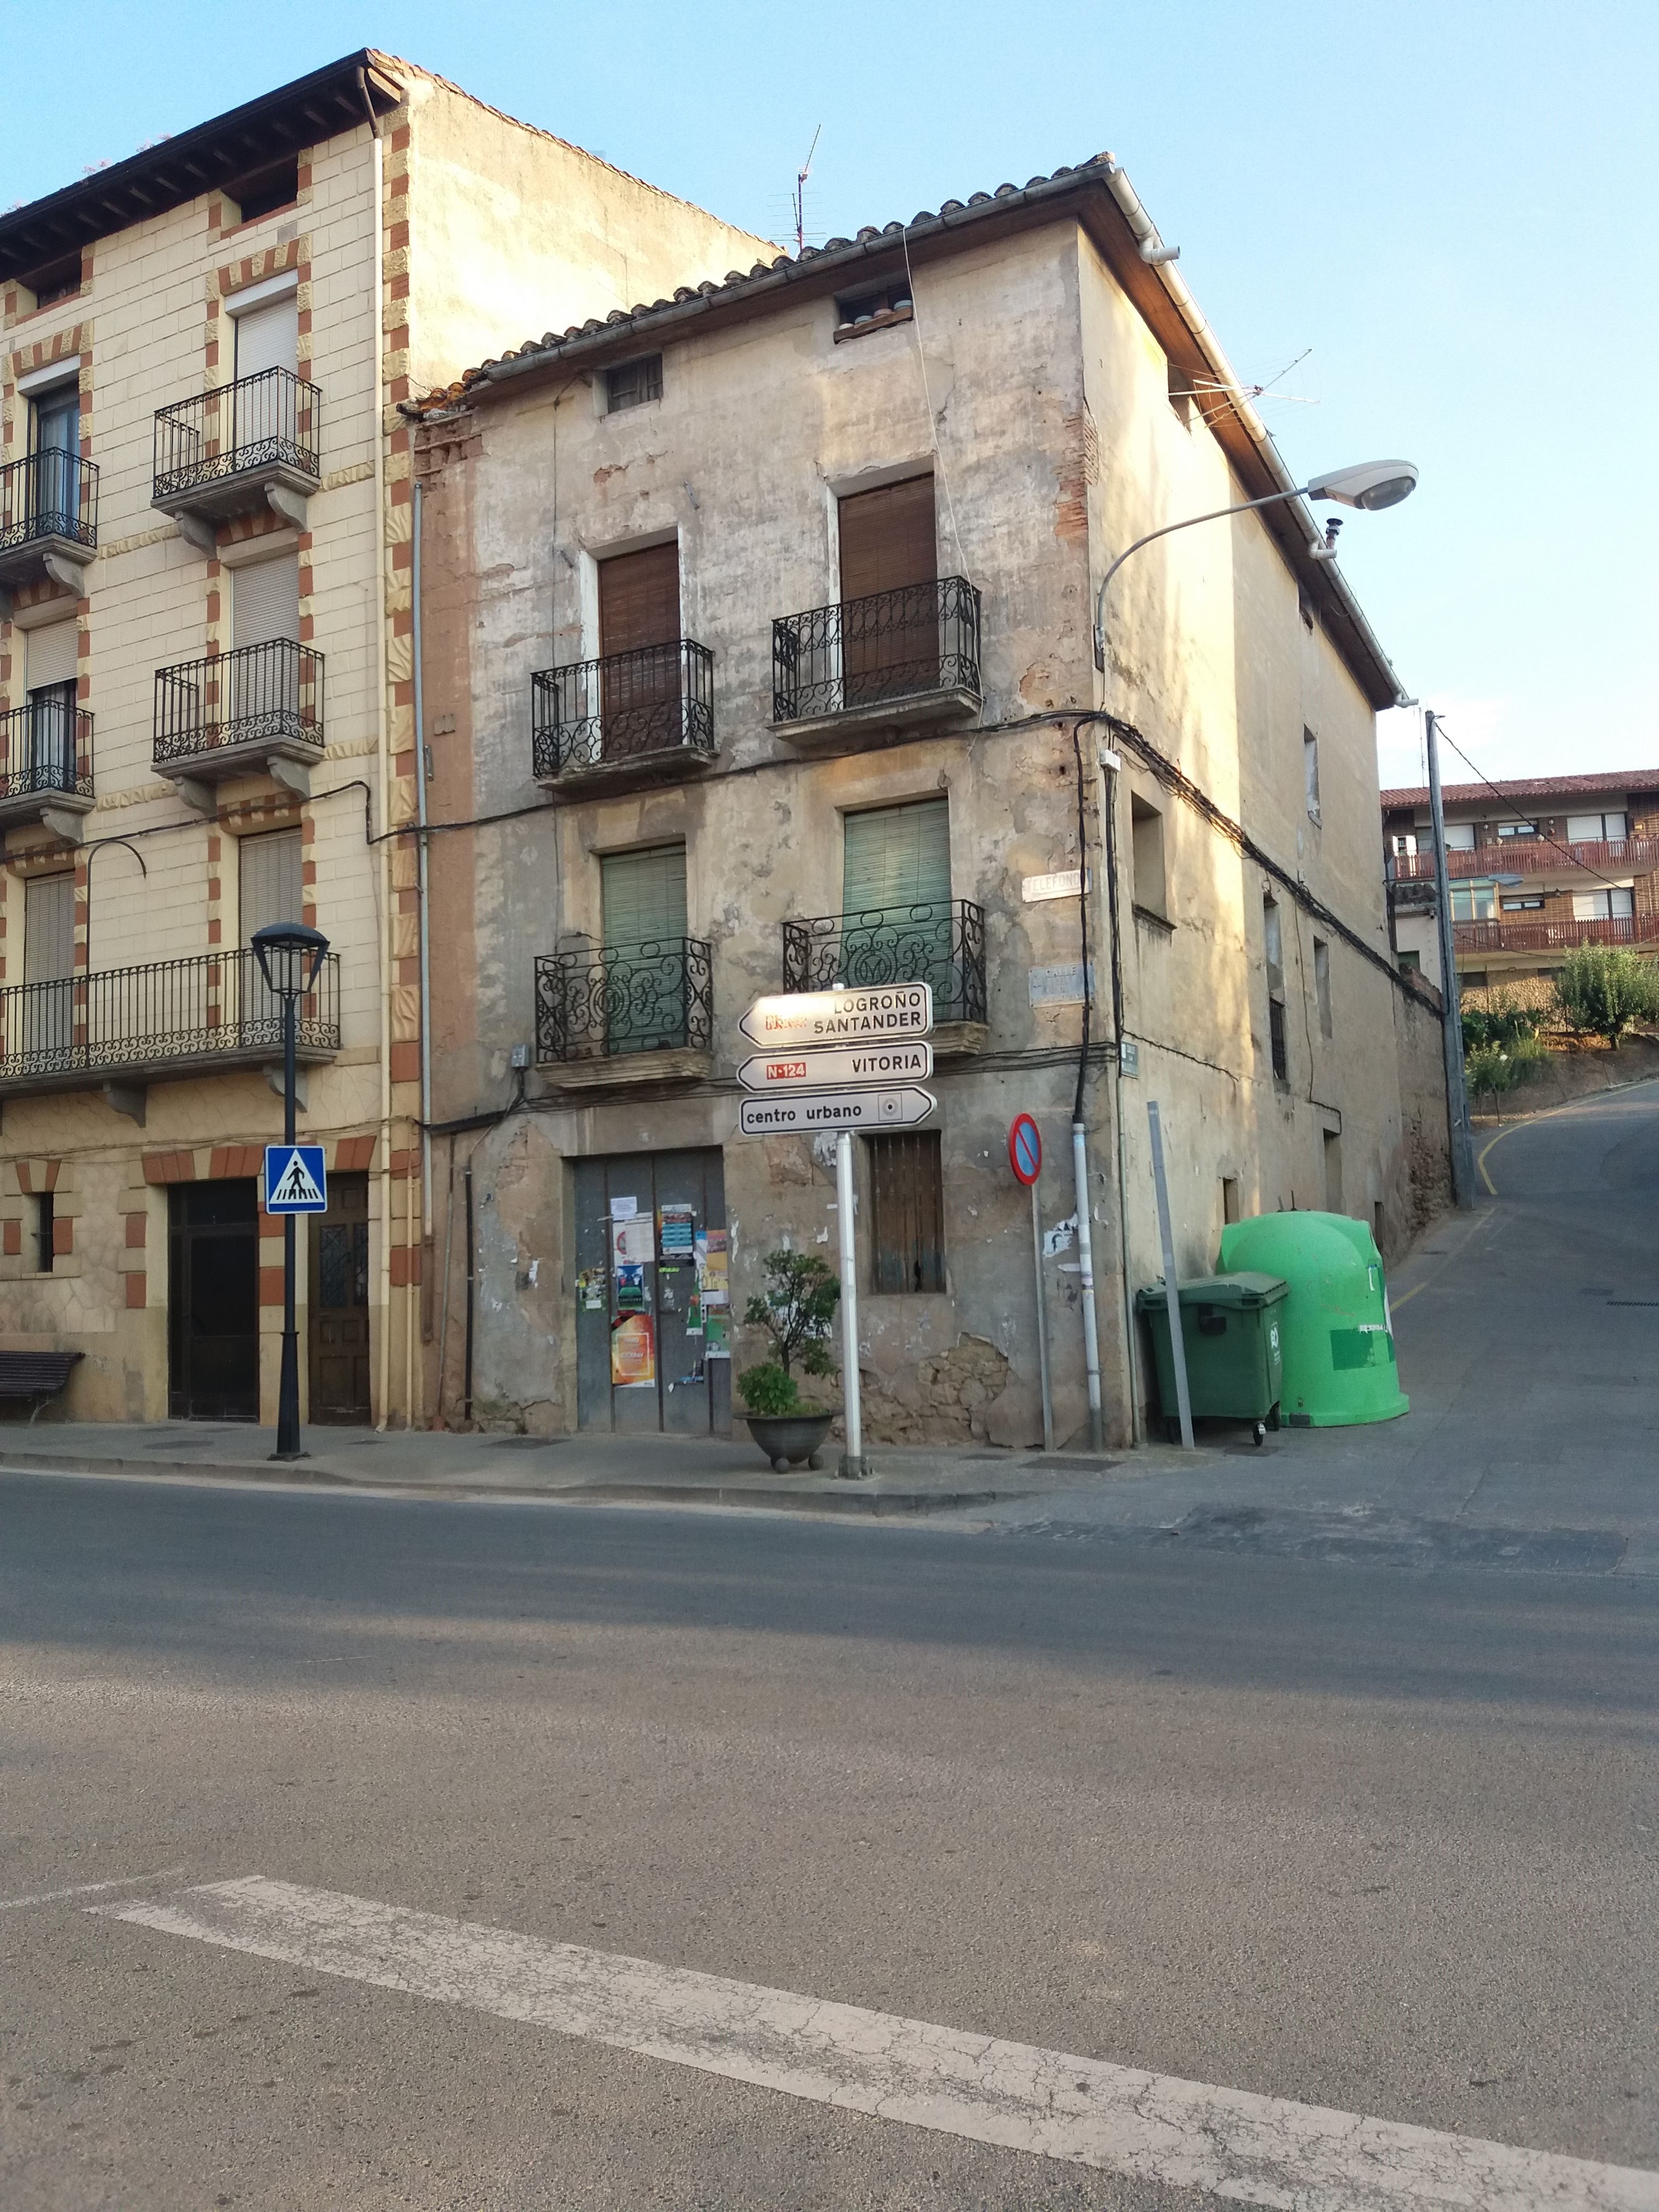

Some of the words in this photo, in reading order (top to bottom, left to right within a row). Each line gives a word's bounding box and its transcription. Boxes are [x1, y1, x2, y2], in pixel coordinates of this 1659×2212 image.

[1027, 872, 1079, 892] TELEFONO
[834, 991, 921, 1014] LOGROÑO
[813, 1011, 921, 1034] SANTANDER
[851, 1054, 921, 1073] VITORIA
[747, 1109, 796, 1124] centro
[806, 1104, 862, 1120] urbano
